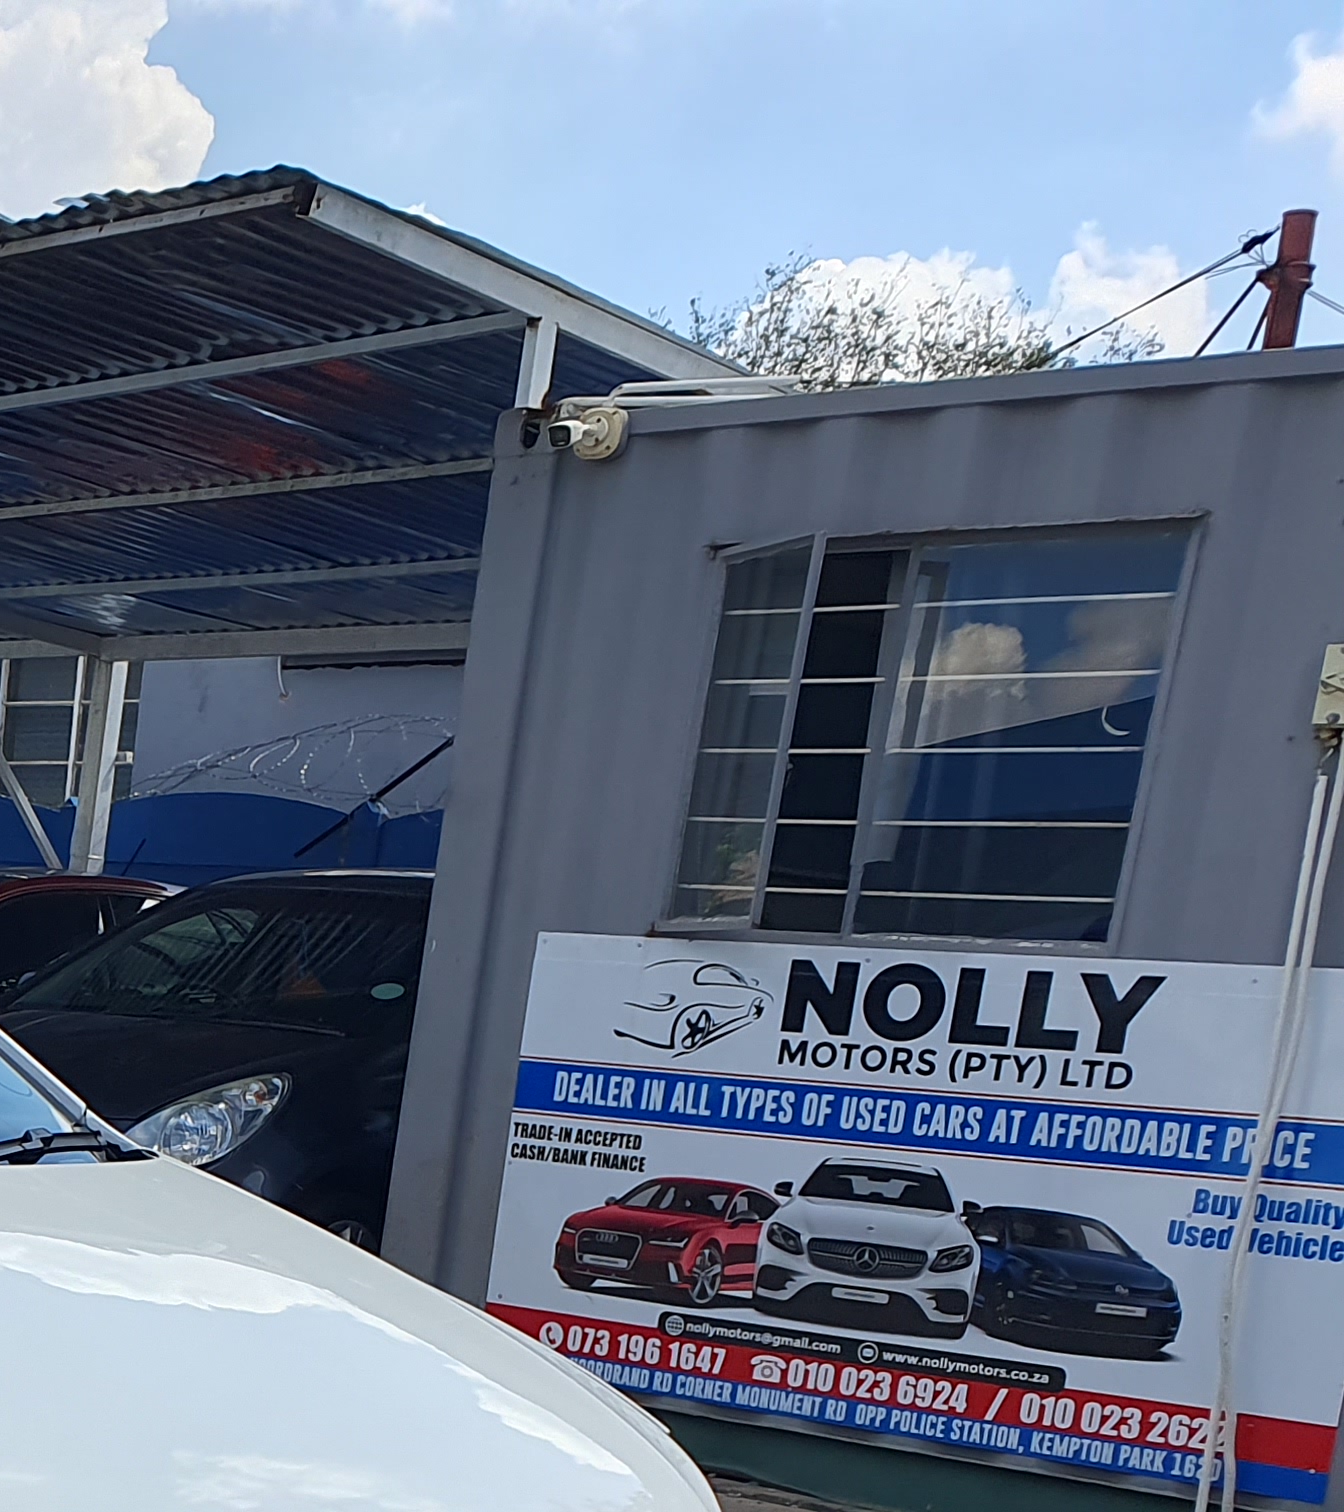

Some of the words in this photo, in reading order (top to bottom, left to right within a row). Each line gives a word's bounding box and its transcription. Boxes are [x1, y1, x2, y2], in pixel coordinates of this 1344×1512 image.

[780, 958, 1168, 1055] NOLLY
[777, 1038, 937, 1077] MOTORS
[948, 1049, 1048, 1090] (PTY)
[1059, 1057, 1134, 1090] LTD
[513, 1121, 573, 1144] TRADE-IN
[574, 1128, 643, 1151] ACCEPTED
[552, 1070, 633, 1110] DEALER
[640, 1078, 666, 1111] IN
[669, 1080, 711, 1117] ALL
[720, 1085, 793, 1125] TYPES
[801, 1091, 834, 1127] OF
[839, 1095, 907, 1134] USED
[912, 1101, 983, 1141] CARS
[988, 1108, 1027, 1145] AT
[1028, 1111, 1217, 1161] AFFORDABLE
[510, 1142, 589, 1167] CASH/BANK
[590, 1151, 647, 1173] FINANCE
[1192, 1188, 1243, 1220] Buy
[1254, 1193, 1344, 1231] Quality
[1167, 1219, 1235, 1251] Used
[566, 1324, 611, 1357] 073
[617, 1332, 662, 1365] 196
[667, 1341, 727, 1375] 1647
[684, 1320, 842, 1356] nollymotors@gmail.com
[881, 1348, 1050, 1385] www.nollymotors.co.za
[570, 1356, 651, 1389] ORDRAND
[652, 1369, 674, 1393] RD
[675, 1372, 732, 1404] CORNER
[735, 1380, 824, 1418] MONUMENT
[824, 1397, 848, 1423] RD
[854, 1402, 887, 1428] OPP
[889, 1408, 945, 1439] POLICE
[950, 1418, 1025, 1454] STATION,
[1029, 1430, 1114, 1466] KEMPTON
[1117, 1445, 1165, 1475] PARK
[786, 1357, 836, 1393] 010
[839, 1364, 892, 1402] 023
[896, 1375, 969, 1414] 6924
[1018, 1392, 1076, 1429] 010
[1080, 1402, 1142, 1440] 023
